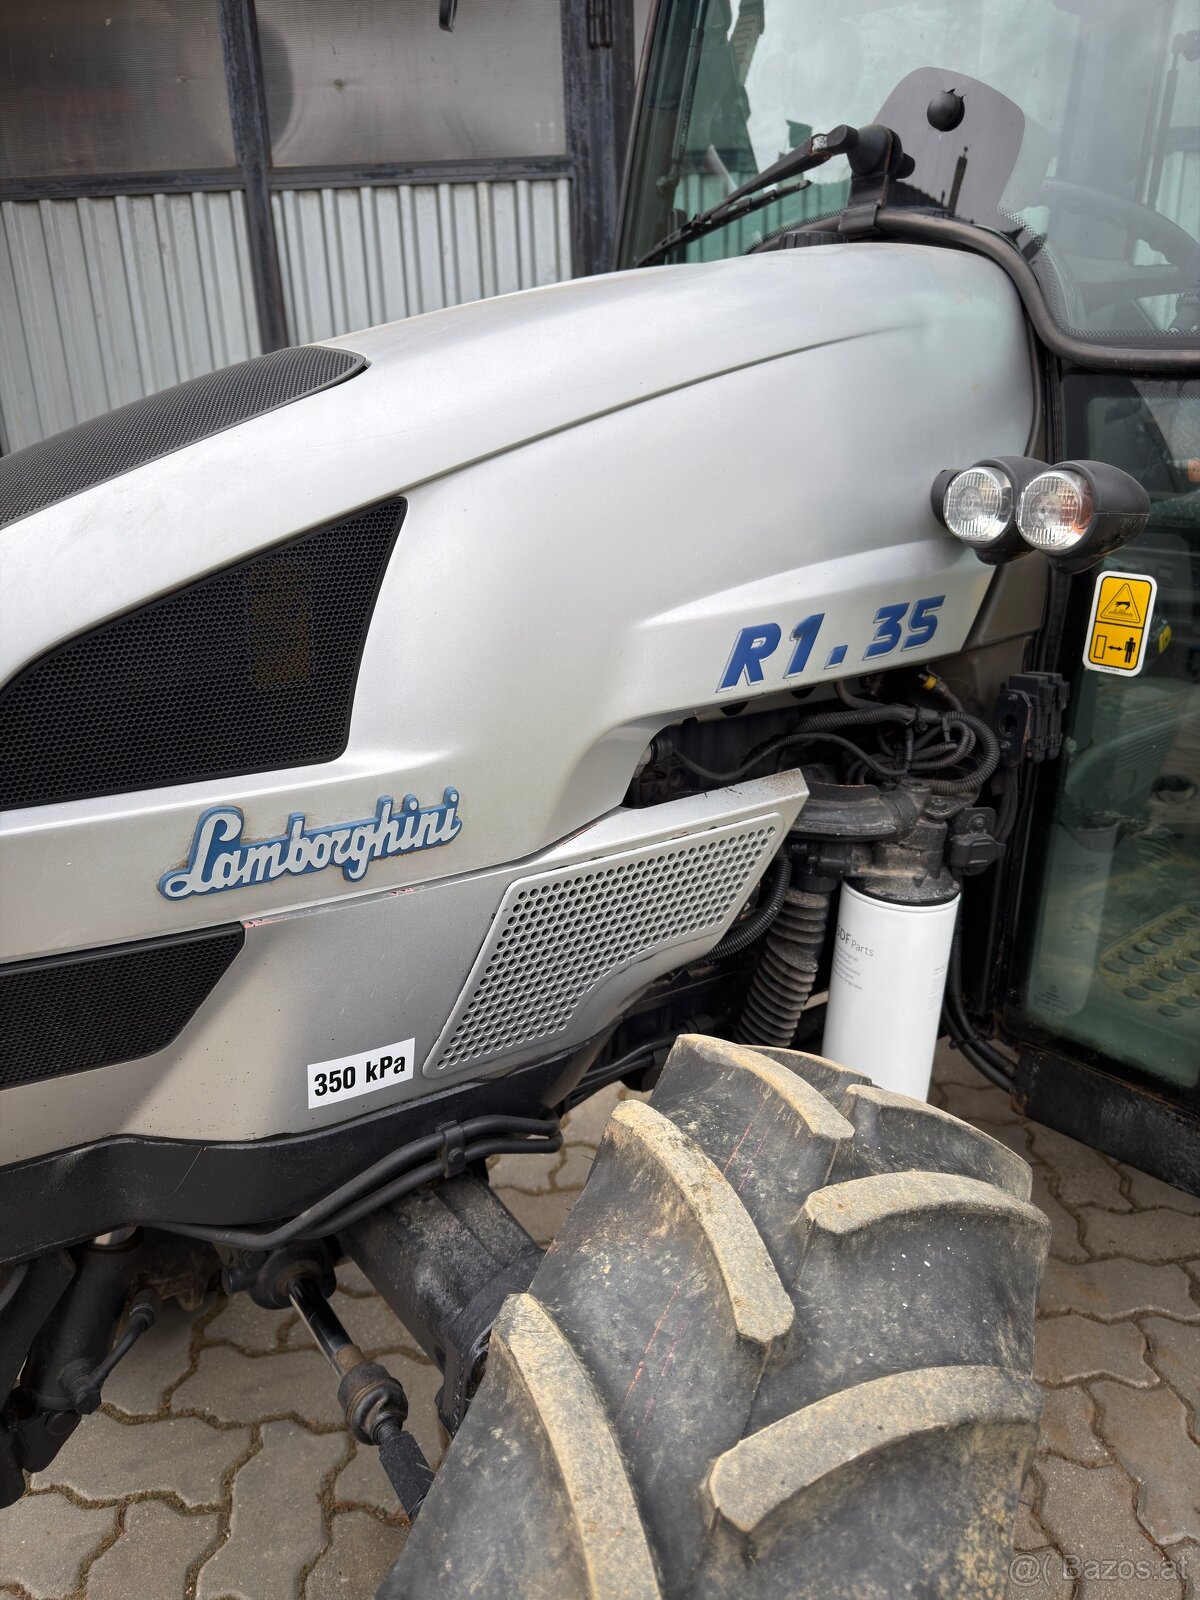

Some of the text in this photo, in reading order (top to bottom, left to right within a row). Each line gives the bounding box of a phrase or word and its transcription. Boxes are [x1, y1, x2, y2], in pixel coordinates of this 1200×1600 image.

[160, 787, 462, 900] Lamborghini
[851, 939, 874, 957] Parts
[314, 1056, 406, 1096] 350 kPa
